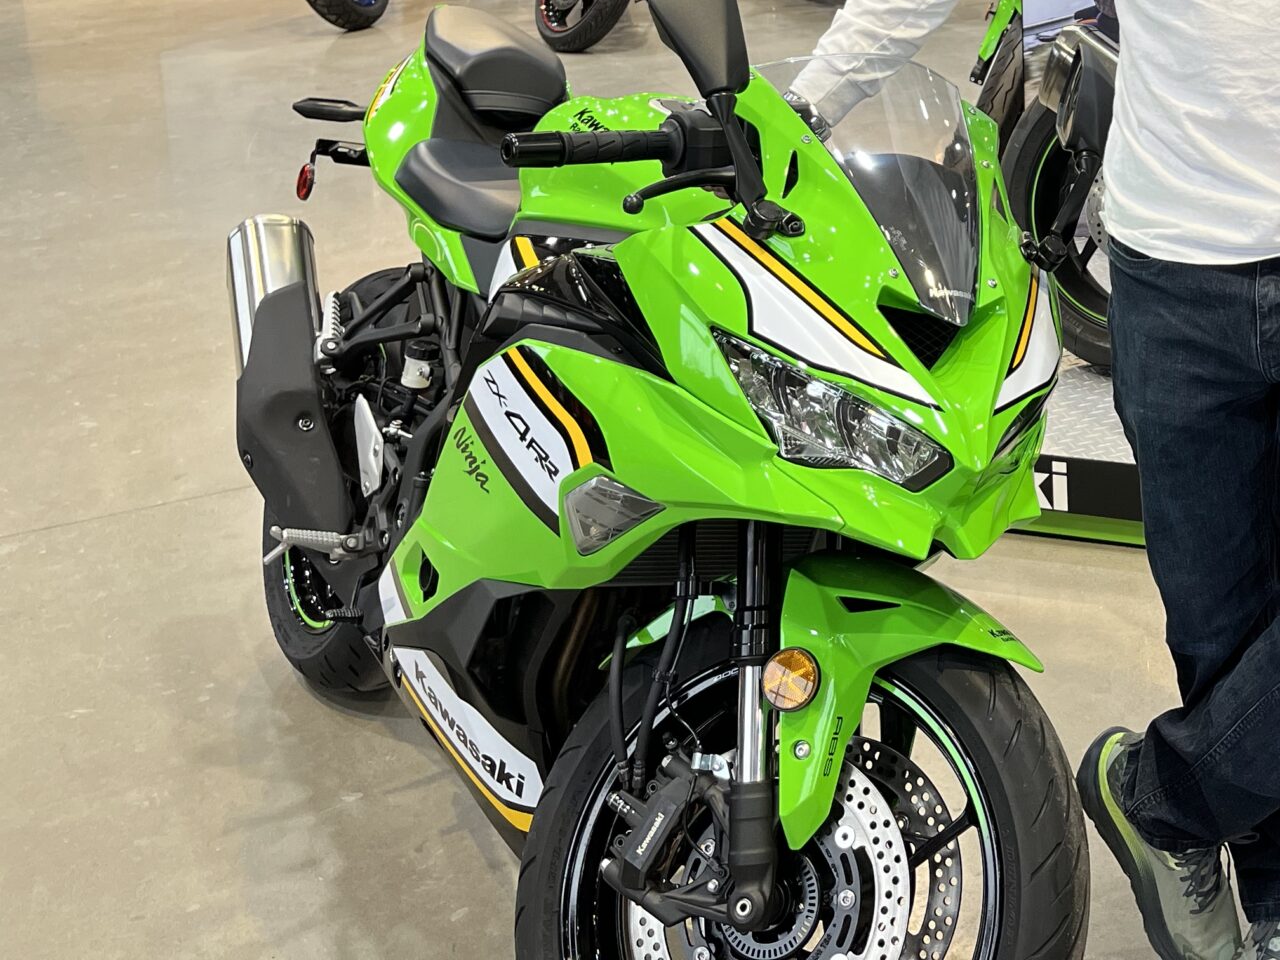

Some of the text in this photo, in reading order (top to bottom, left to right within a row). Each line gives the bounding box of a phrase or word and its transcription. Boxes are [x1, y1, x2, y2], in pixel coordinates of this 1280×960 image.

[453, 426, 490, 494] Ninja
[413, 659, 526, 800] Kawasaki
[636, 812, 665, 856] Kawasaki
